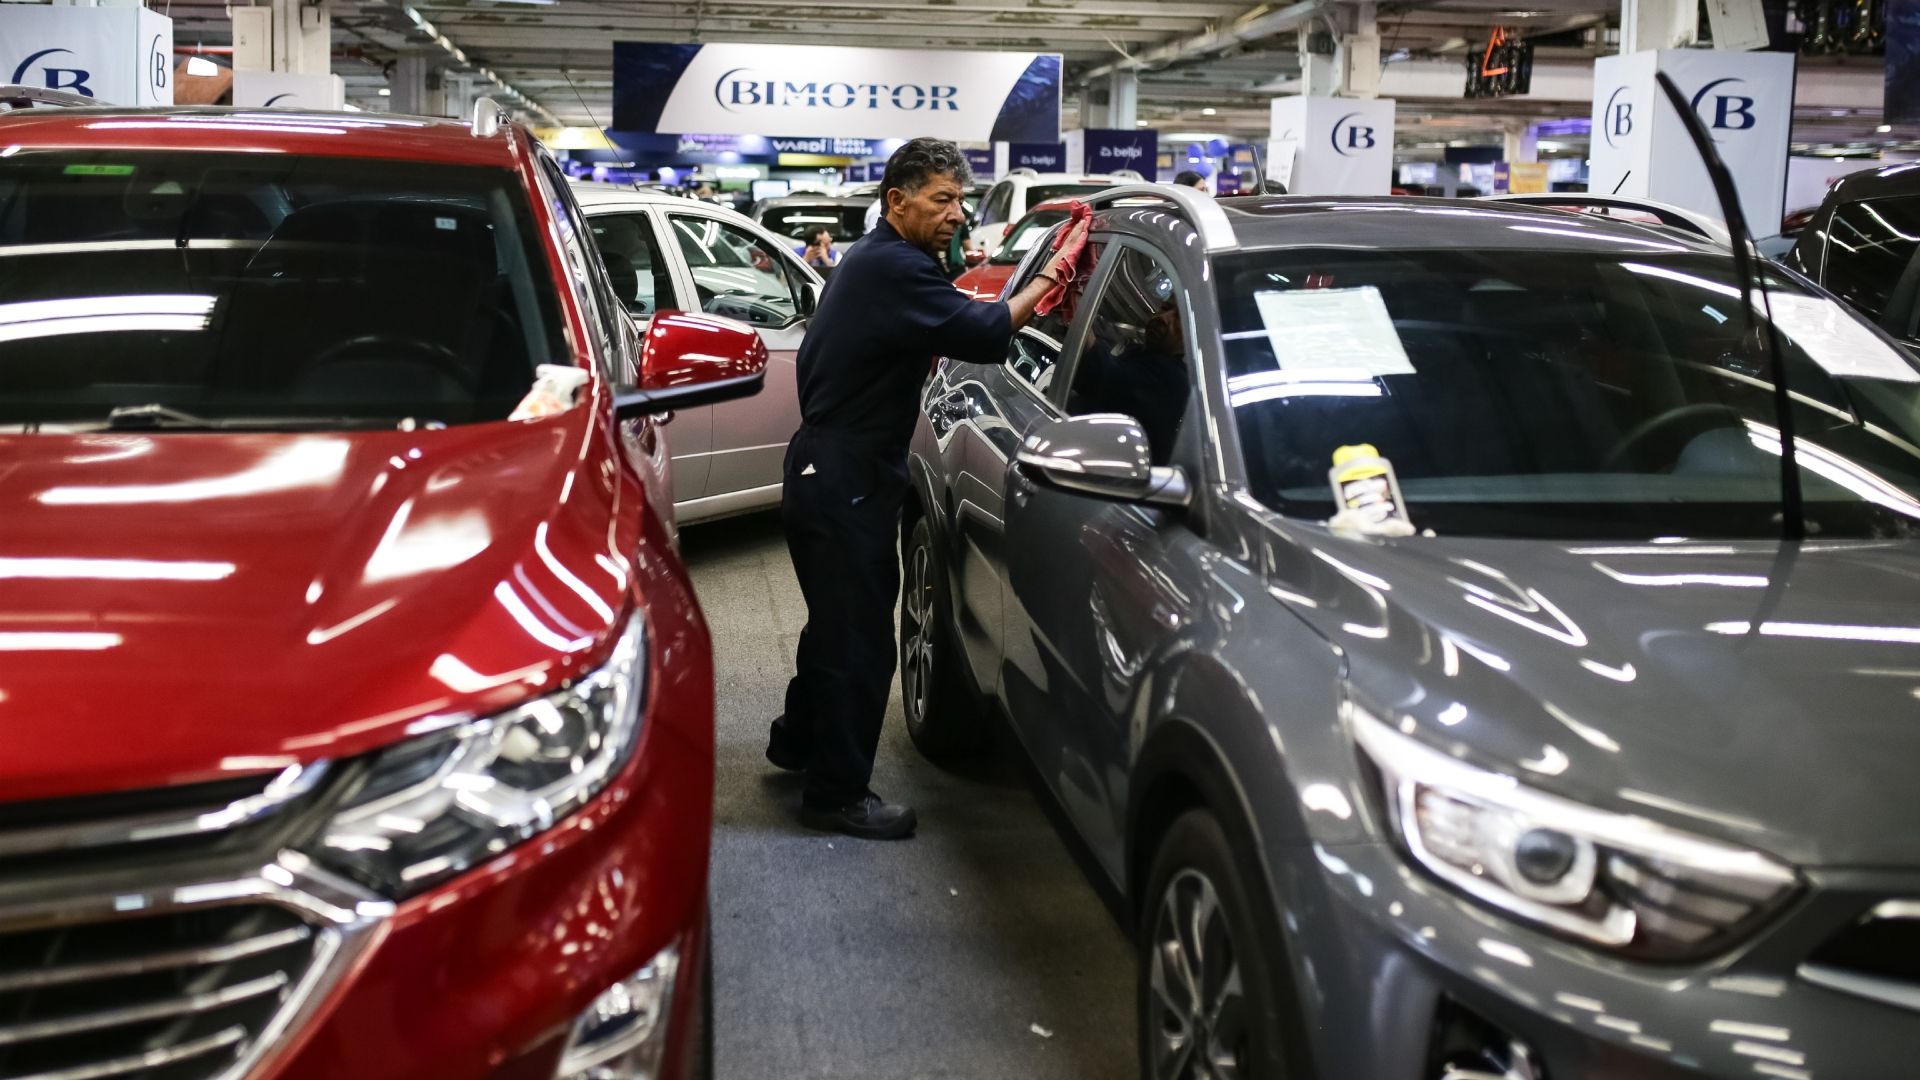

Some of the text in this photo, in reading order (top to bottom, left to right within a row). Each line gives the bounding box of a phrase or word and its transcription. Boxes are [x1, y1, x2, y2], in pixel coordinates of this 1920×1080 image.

[42, 67, 94, 98] B
[156, 51, 166, 88] B
[730, 80, 960, 112] BIMOTOR
[1614, 103, 1633, 136] B
[1712, 95, 1756, 130] B
[1347, 125, 1376, 149] B
